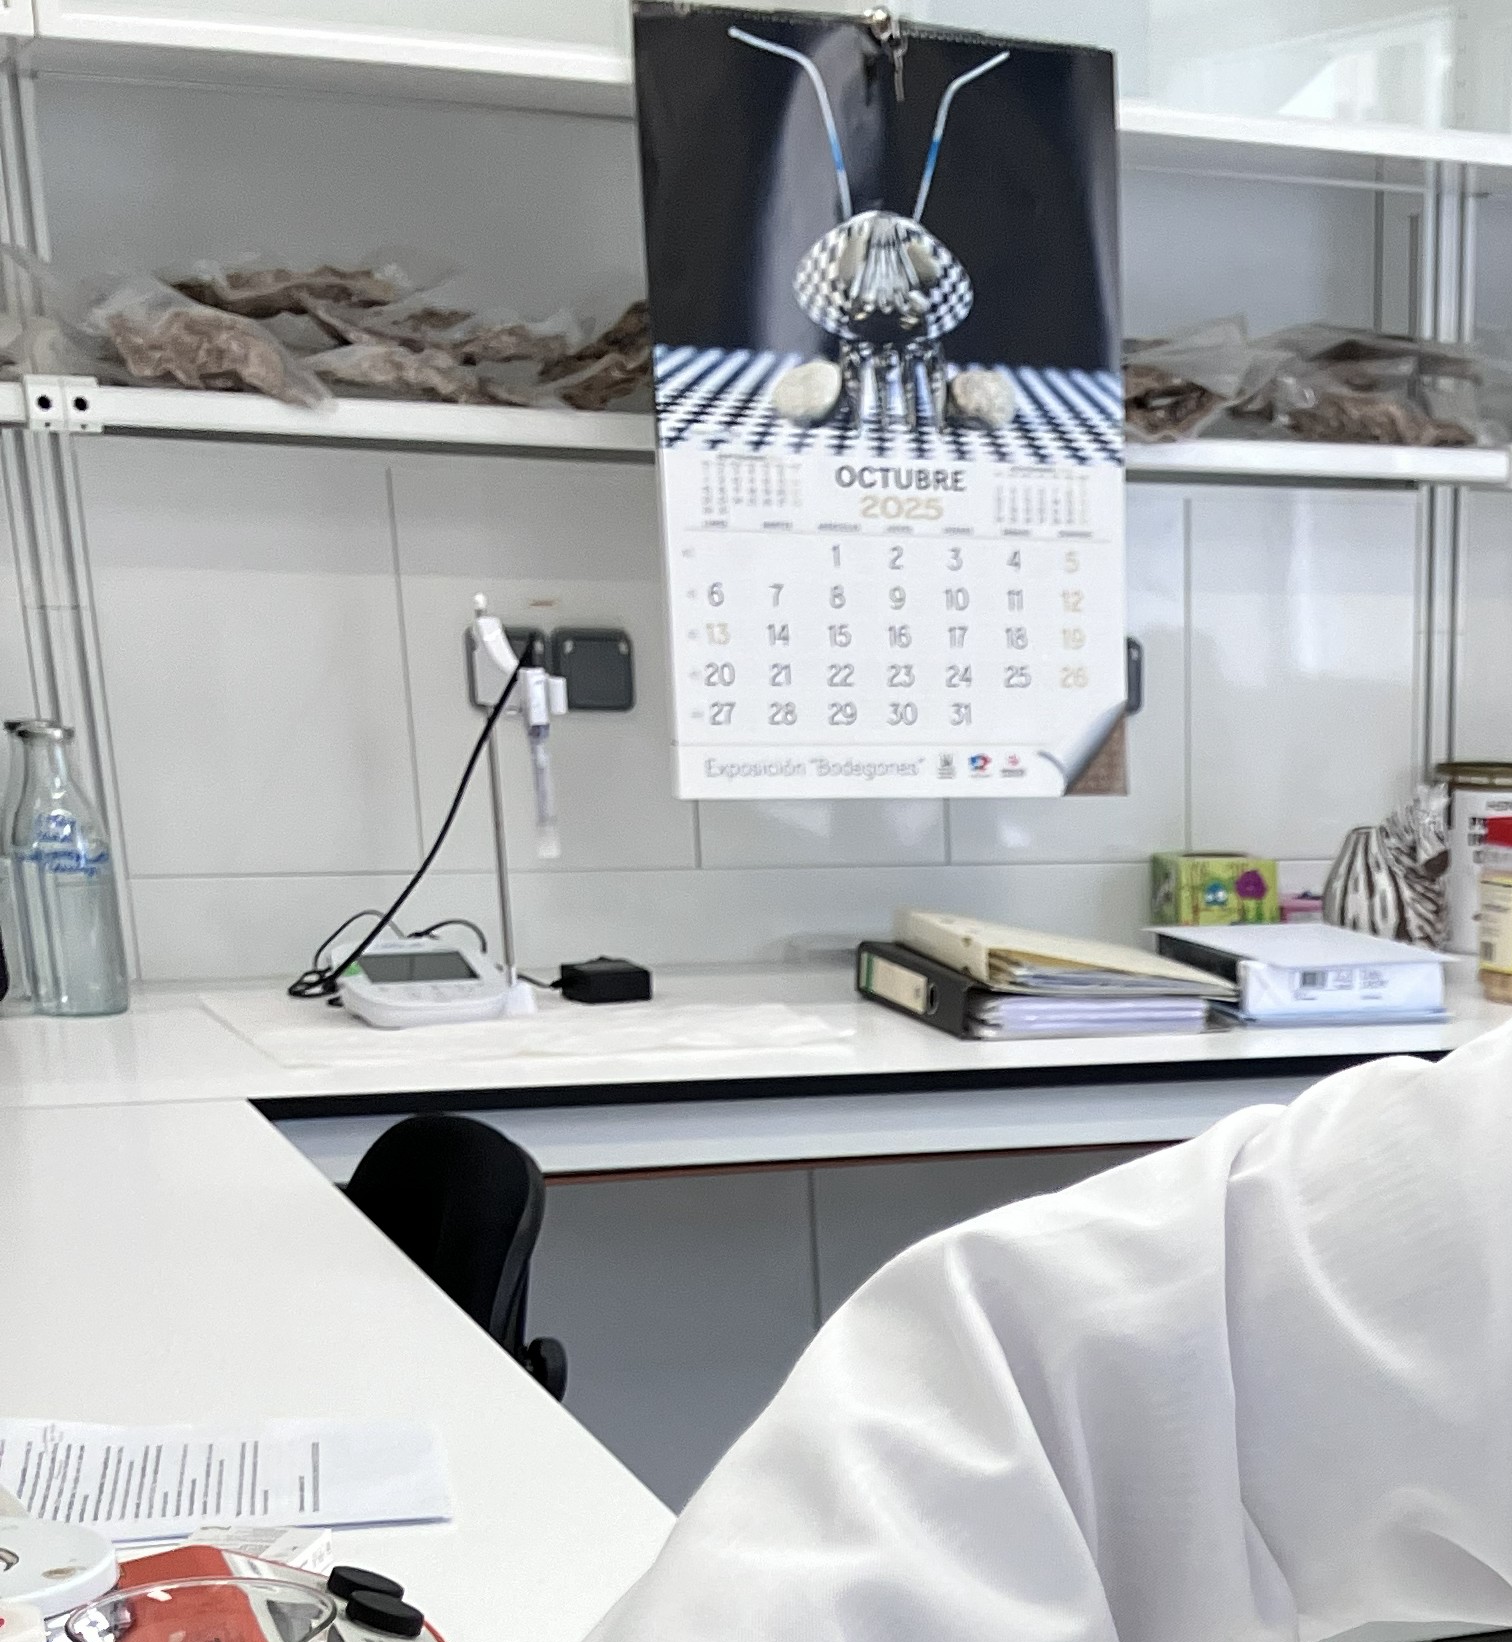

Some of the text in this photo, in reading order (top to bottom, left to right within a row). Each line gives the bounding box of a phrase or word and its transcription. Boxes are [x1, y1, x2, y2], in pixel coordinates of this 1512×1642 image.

[835, 465, 965, 492] OCTUBRE
[860, 494, 944, 521] 2025
[831, 544, 1080, 574] 1 2 3 4 5
[708, 582, 724, 607] 6
[769, 583, 784, 607] 7
[830, 585, 846, 609] 8
[889, 586, 906, 610] 9
[944, 587, 970, 611] 10
[1007, 589, 1023, 611] 11
[1060, 590, 1084, 613] 12
[705, 622, 730, 645] 13
[767, 624, 790, 645] 14
[827, 624, 852, 648] 15
[888, 624, 912, 648] 16
[948, 625, 968, 647] 17
[1005, 627, 1028, 650] 18
[1060, 626, 1086, 650] 19
[705, 662, 735, 687] 20
[770, 663, 791, 687] 21
[827, 663, 854, 687] 22
[887, 664, 915, 688] 23
[946, 665, 972, 688] 24
[1004, 665, 1031, 688] 25
[1059, 665, 1089, 689] 26
[710, 701, 736, 726] 27
[769, 701, 797, 726] 28
[828, 702, 857, 726] 29
[887, 702, 918, 726] 30
[951, 702, 972, 726] 31
[704, 758, 806, 783] Exposición
